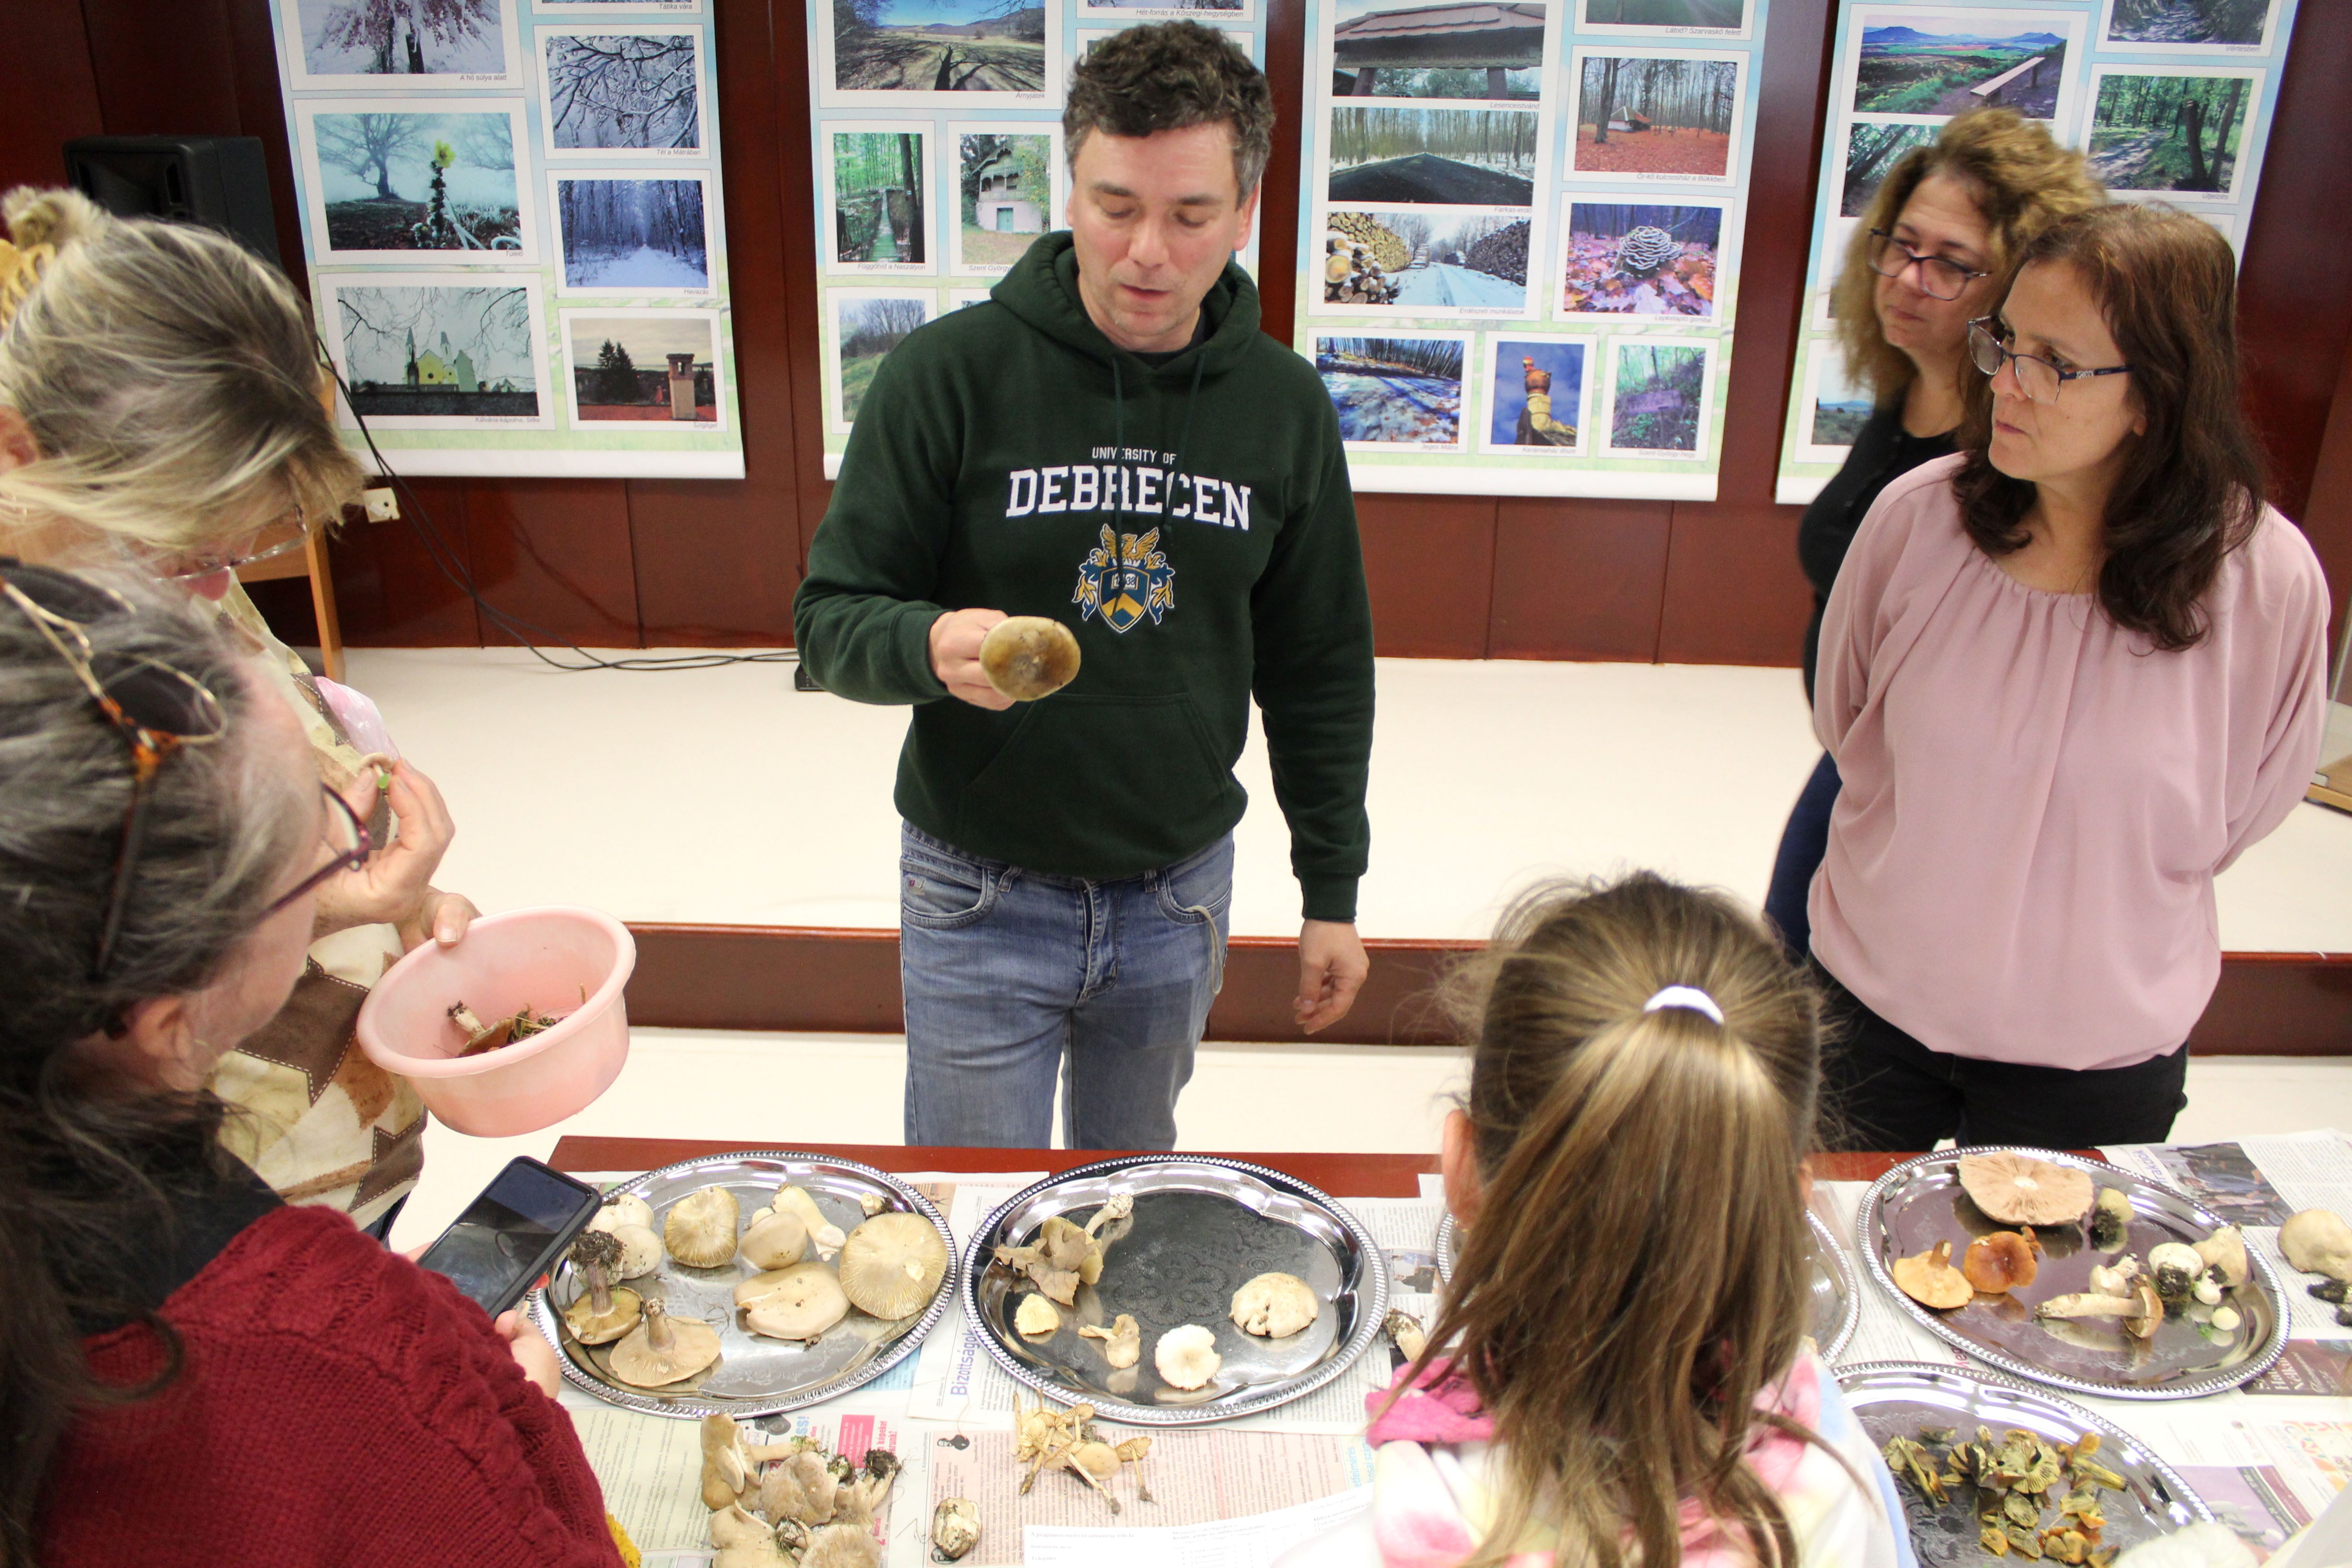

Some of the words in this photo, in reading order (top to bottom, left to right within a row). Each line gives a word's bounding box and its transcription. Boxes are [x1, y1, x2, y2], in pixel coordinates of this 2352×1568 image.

[1162, 452, 1177, 465] OF
[1005, 465, 1251, 531] DEBRECEN
[1115, 575, 1136, 585] 138
[950, 1329, 980, 1396] Bizottságok
[876, 1421, 888, 1445] képeket
